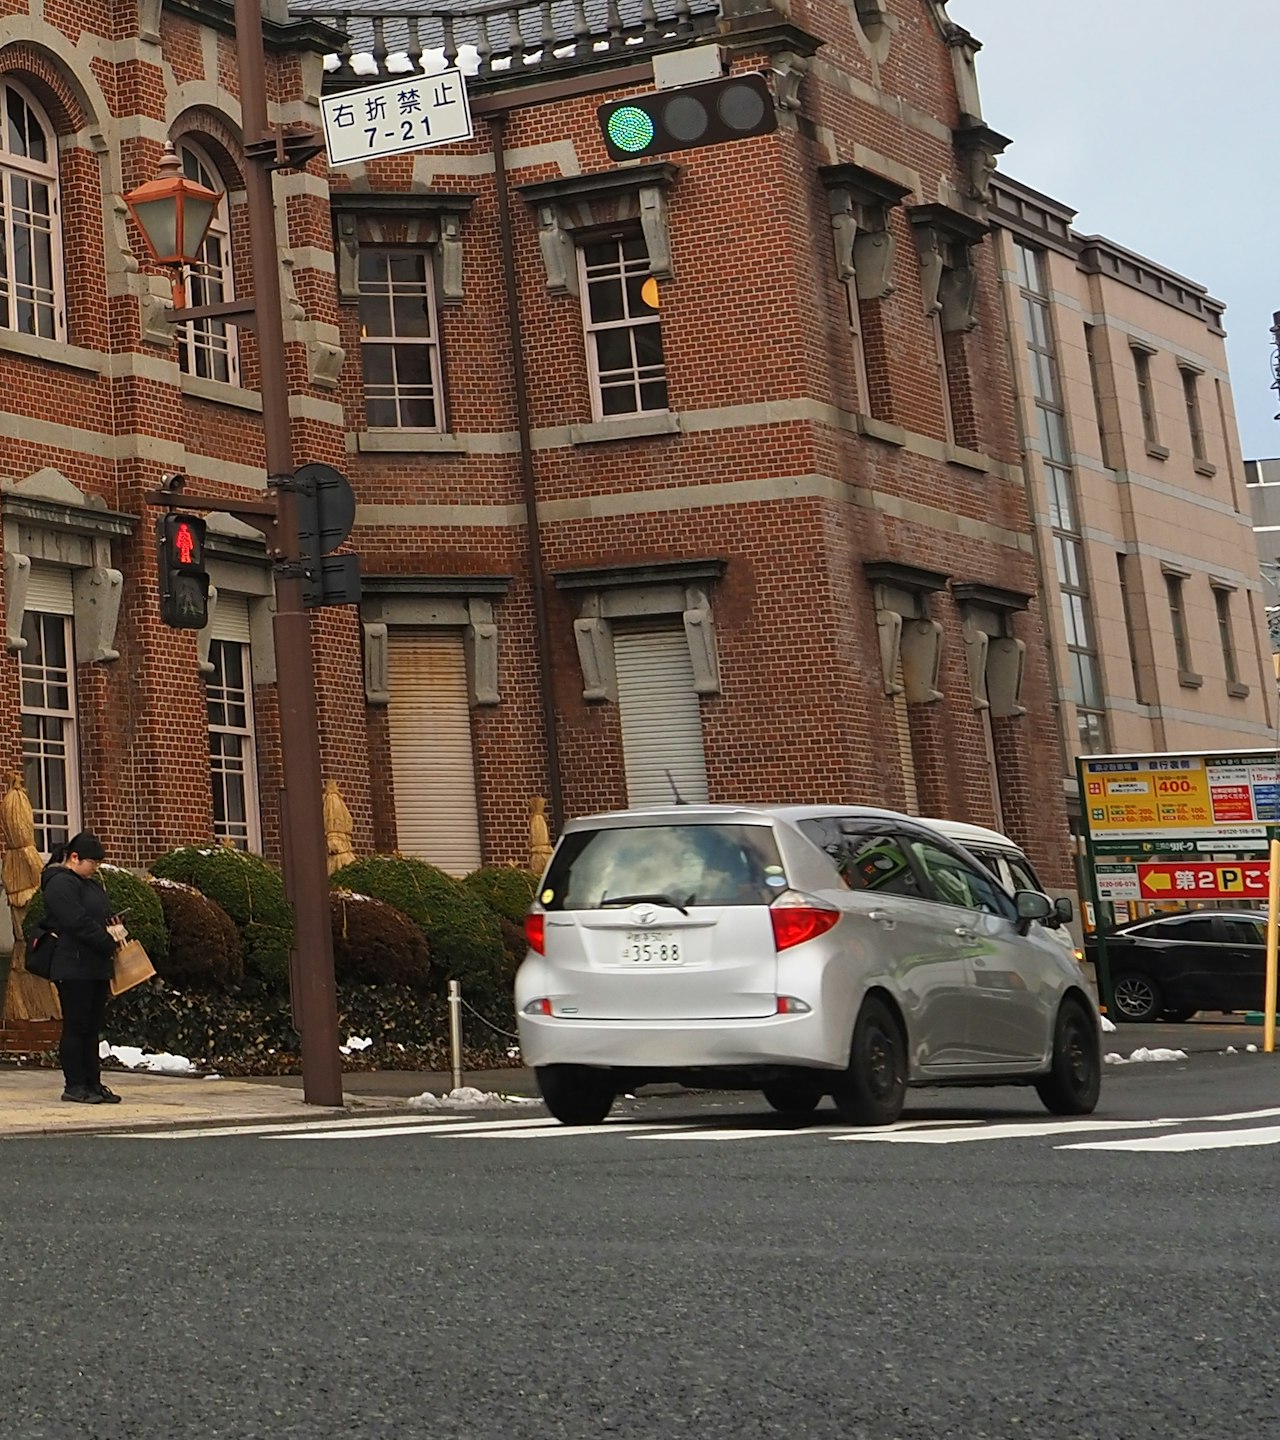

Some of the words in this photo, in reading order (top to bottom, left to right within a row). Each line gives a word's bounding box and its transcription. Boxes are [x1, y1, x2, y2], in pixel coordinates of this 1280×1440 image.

[332, 82, 456, 128] 右折禁止
[364, 116, 432, 148] 7-21
[632, 944, 680, 961] 35-88
